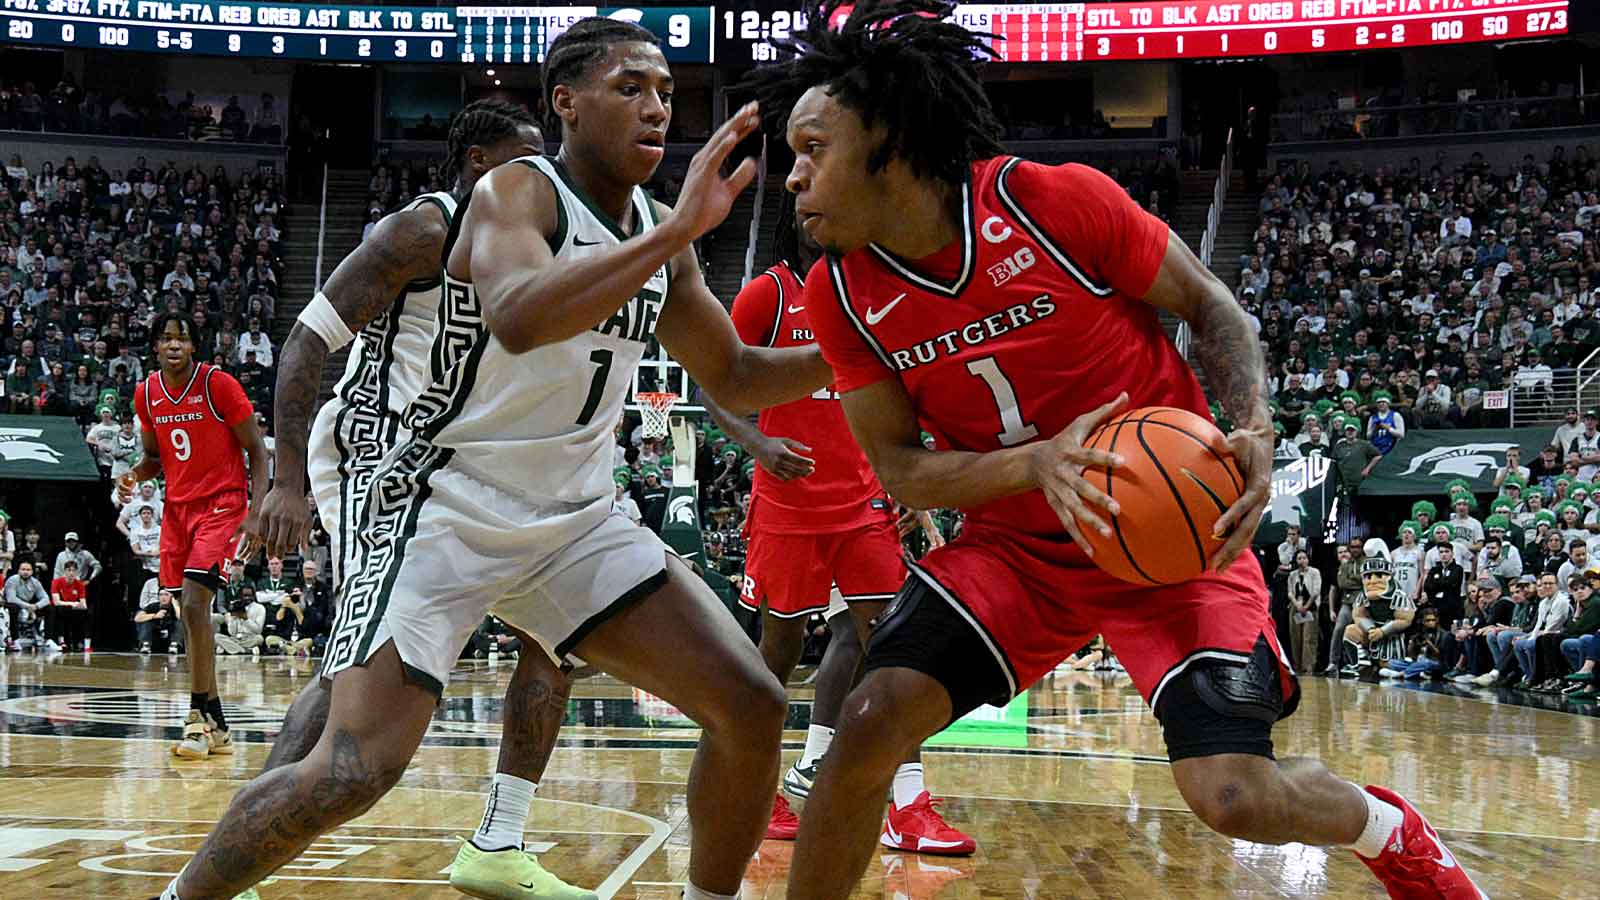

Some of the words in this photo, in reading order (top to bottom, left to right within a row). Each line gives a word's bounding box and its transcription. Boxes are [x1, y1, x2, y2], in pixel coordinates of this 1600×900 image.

[98, 0, 130, 17] FT%
[138, 1, 214, 22] FTM-FTA
[219, 5, 252, 24] REB
[257, 7, 301, 26] OREB
[305, 9, 341, 28] AST
[349, 10, 383, 29] BLK
[390, 11, 413, 30] TO
[421, 12, 454, 30] STL
[961, 14, 988, 26] FLS
[1087, 8, 1121, 27] STL
[1129, 8, 1153, 26] TO
[1162, 6, 1198, 25] BLK
[1205, 4, 1242, 23] AST
[1248, 2, 1293, 21] OREB
[1301, 0, 1336, 19] REB
[9, 20, 33, 39] 20
[62, 23, 75, 42] 0
[98, 26, 129, 46] 100
[157, 30, 193, 50] 5-5
[272, 35, 285, 54] 3
[319, 37, 327, 56] 1
[358, 38, 371, 57] 2
[395, 39, 407, 58] 3
[430, 39, 443, 58] 0
[668, 14, 690, 48] 9
[1097, 37, 1110, 56] 3
[1137, 36, 1145, 55] 1
[1176, 35, 1184, 54] 1
[1221, 33, 1229, 53] 1
[1264, 31, 1277, 50] 0
[1311, 28, 1325, 48] 5
[1431, 20, 1464, 40] 100
[1482, 15, 1508, 37] 50
[1526, 10, 1567, 33] 27.3
[981, 216, 1012, 244] C
[592, 288, 664, 343] ATE
[891, 295, 1056, 371] RUTGERS
[575, 349, 614, 426] 1
[966, 356, 1039, 447] 1
[1487, 398, 1505, 408] EXIT
[155, 412, 203, 424] RUTGERS
[170, 428, 191, 462] 9
[741, 575, 755, 600] R
